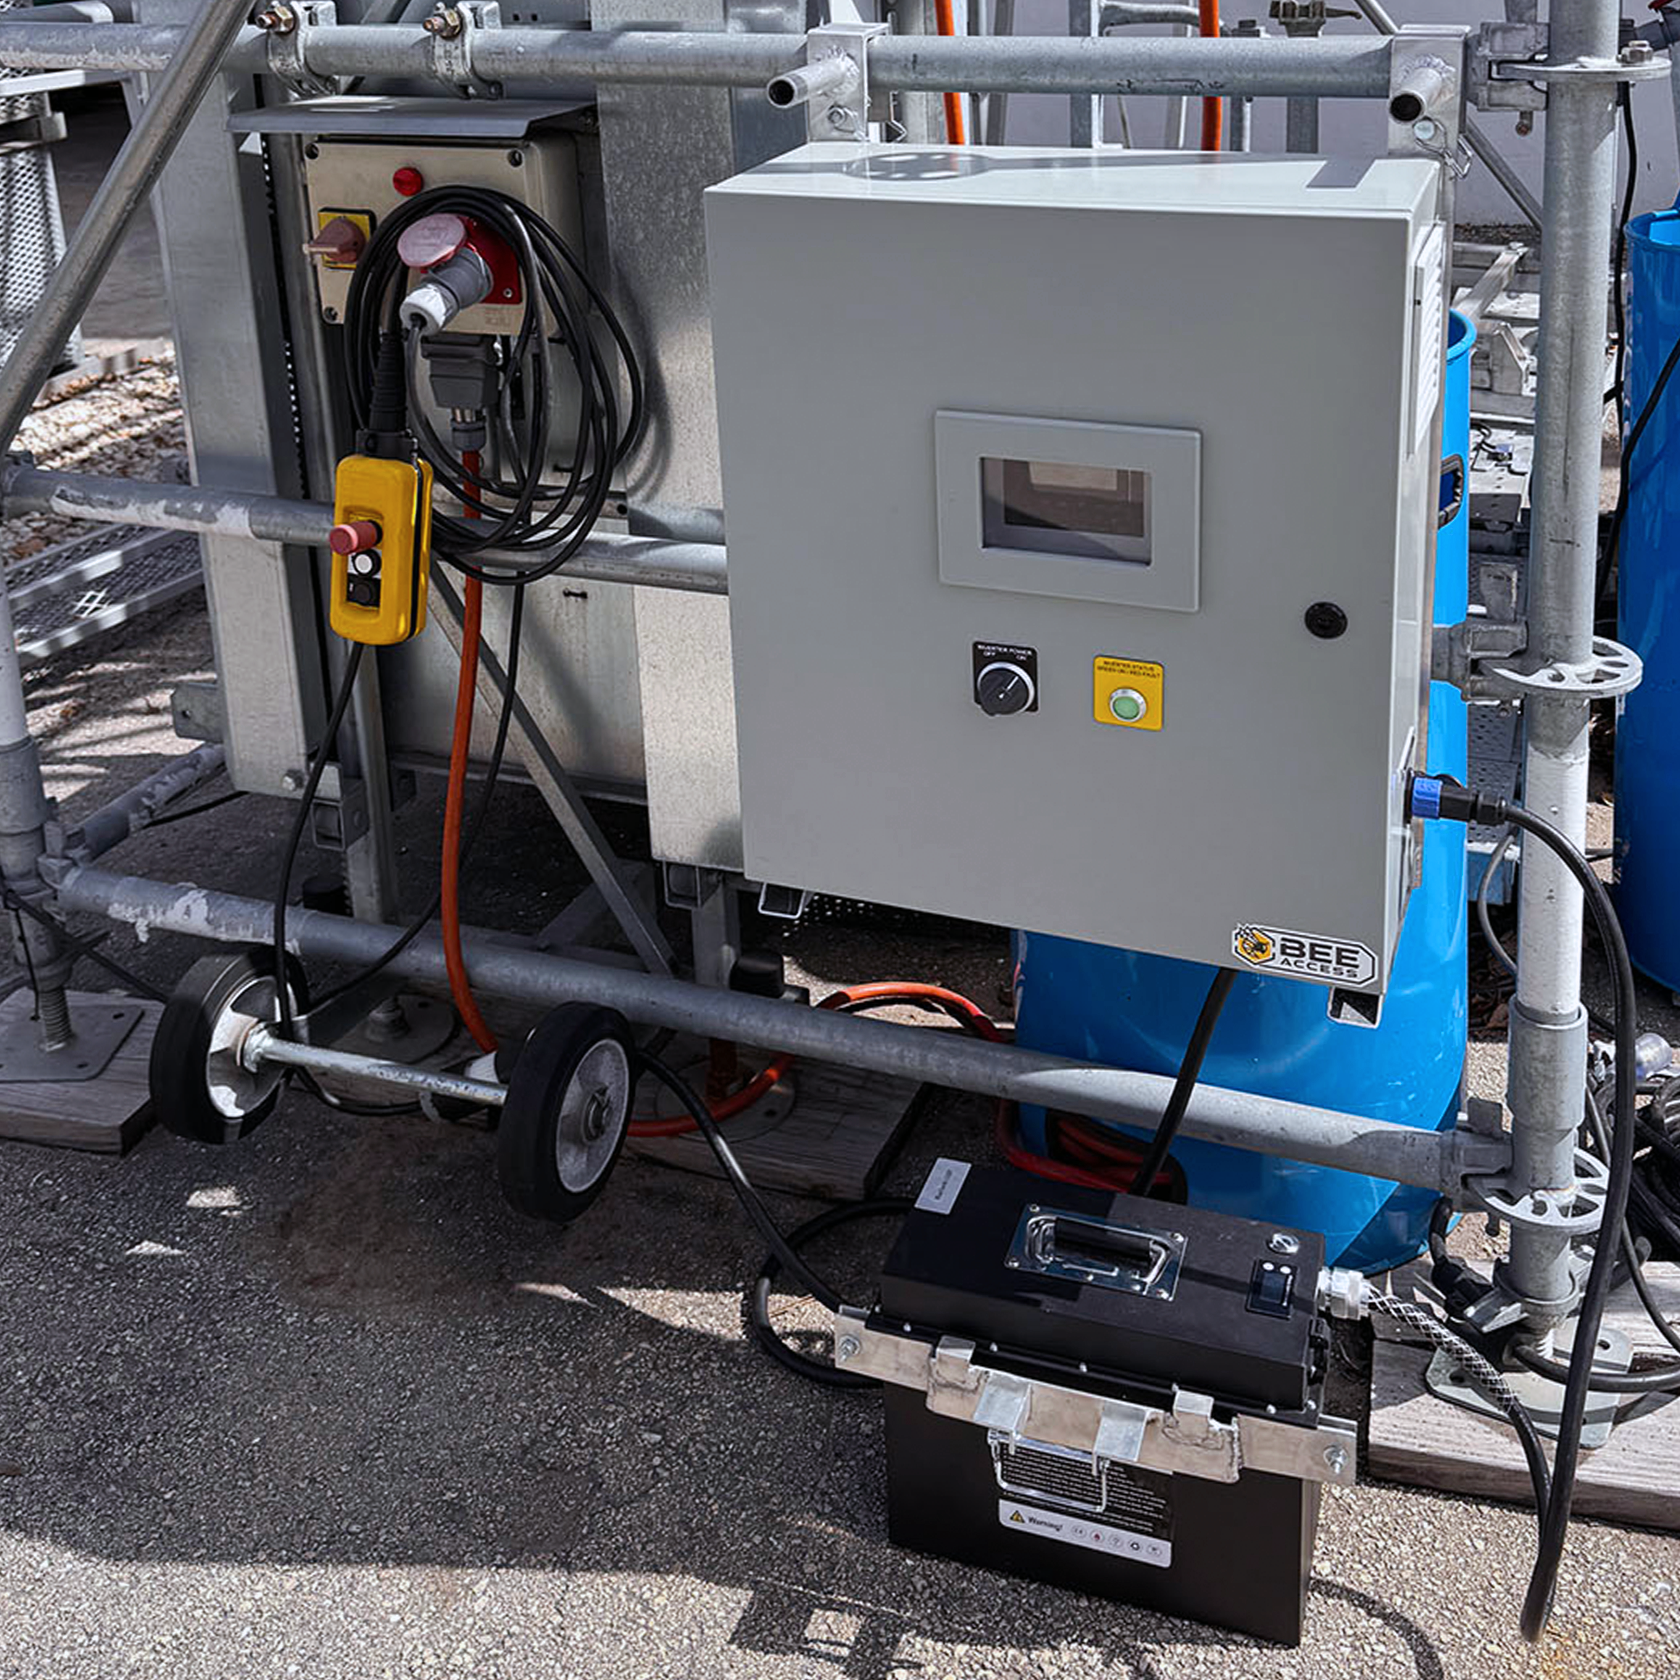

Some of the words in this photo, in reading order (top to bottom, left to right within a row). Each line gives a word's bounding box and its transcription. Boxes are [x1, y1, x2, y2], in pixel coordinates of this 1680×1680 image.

[1009, 648, 1032, 656] POWER
[1280, 937, 1360, 969] BEE
[1280, 957, 1358, 978] ACCESS
